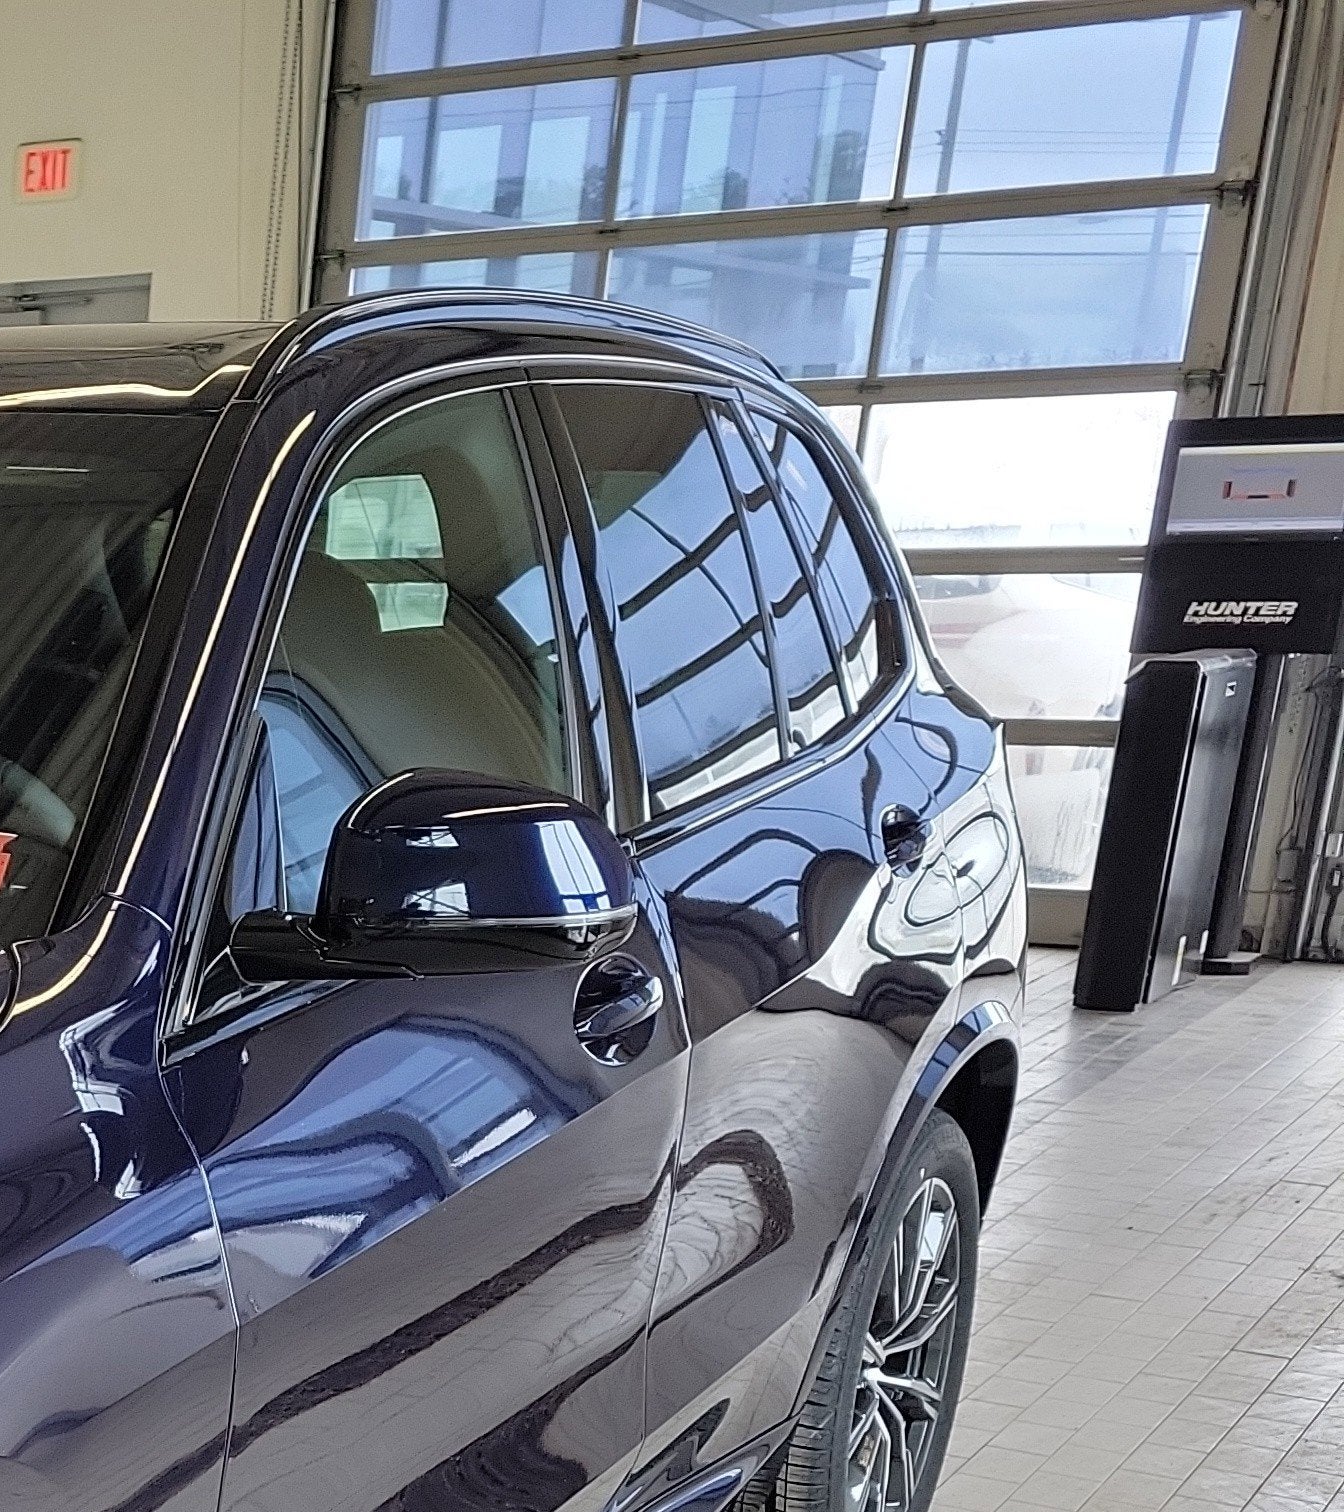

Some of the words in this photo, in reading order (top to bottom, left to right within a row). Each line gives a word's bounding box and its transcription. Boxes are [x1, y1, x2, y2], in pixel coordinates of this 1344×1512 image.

[25, 149, 71, 193] EXIT
[1187, 601, 1299, 615] HUNTER
[1183, 615, 1242, 624] Engineering
[1242, 615, 1293, 624] Company
